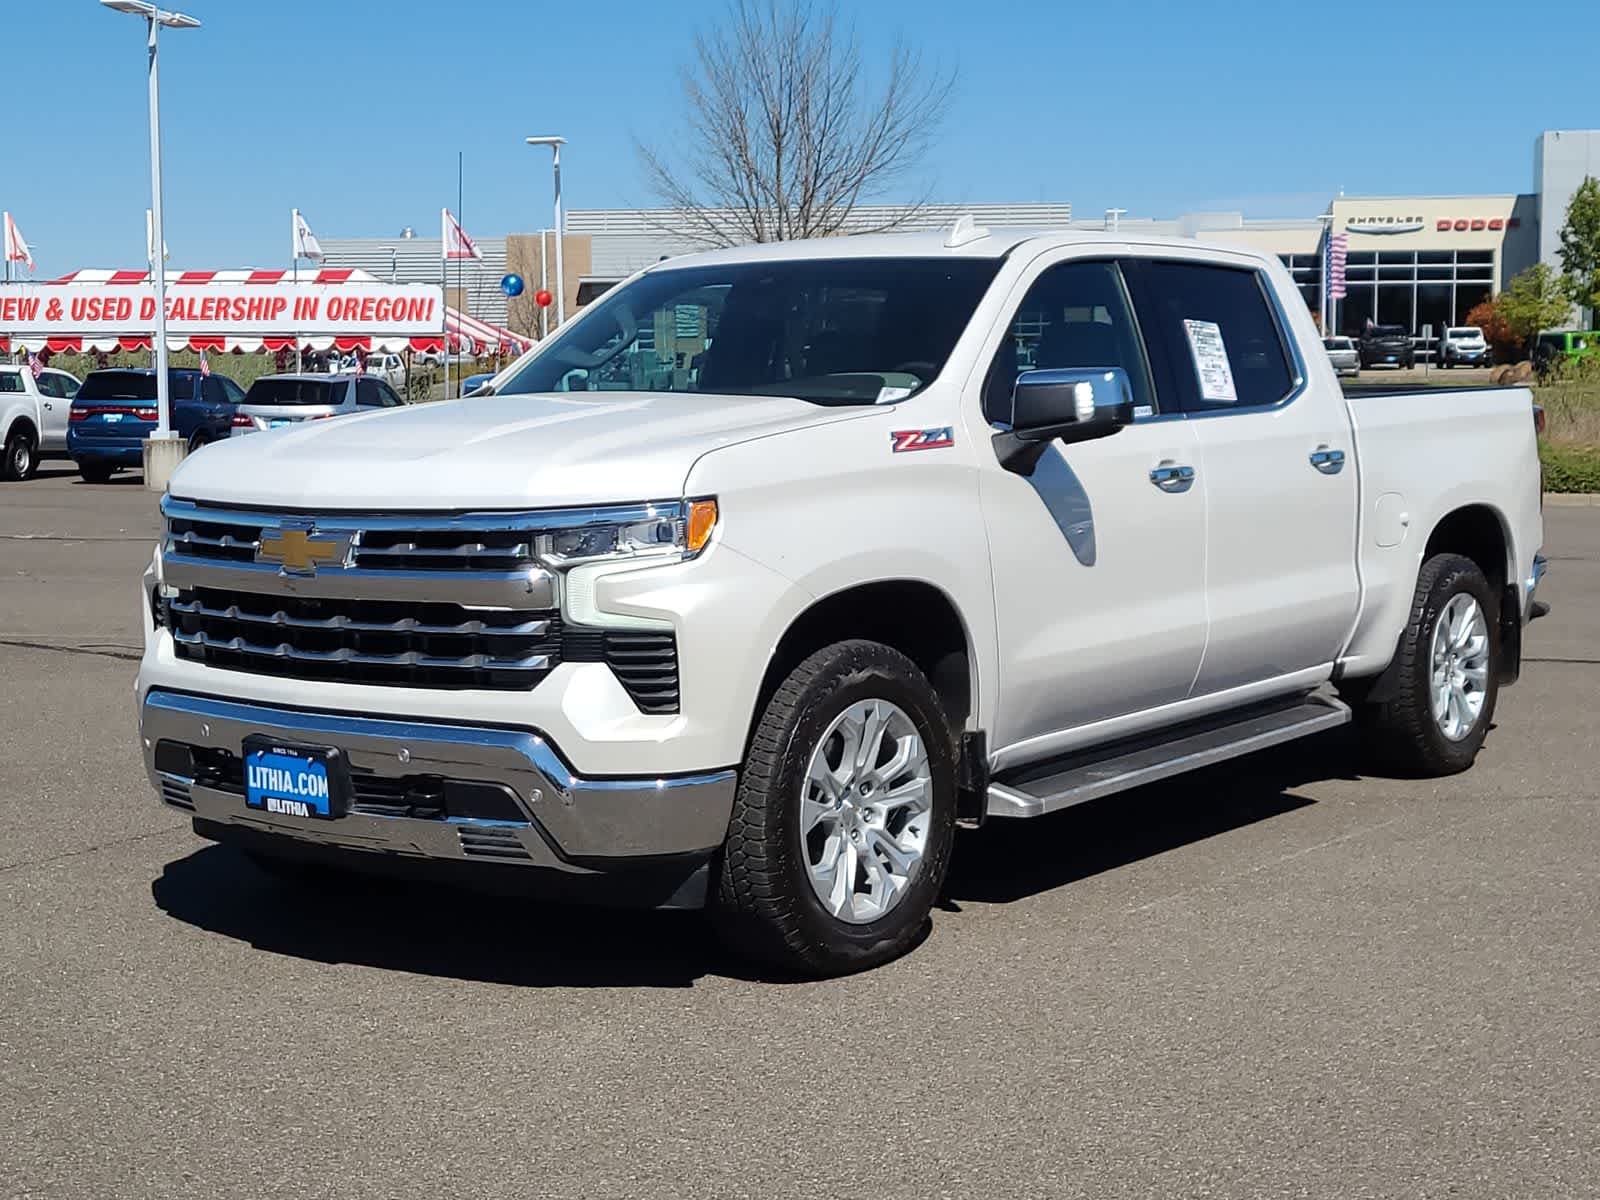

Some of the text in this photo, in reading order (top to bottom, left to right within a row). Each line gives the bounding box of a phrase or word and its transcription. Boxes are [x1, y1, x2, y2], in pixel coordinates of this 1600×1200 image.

[0, 297, 40, 321] EW
[45, 297, 64, 321] &
[70, 297, 132, 321] USED
[293, 297, 320, 321] IN
[326, 297, 434, 321] OREGON!
[248, 765, 329, 798] LITHIA.COM
[276, 799, 309, 817] LITHIA
